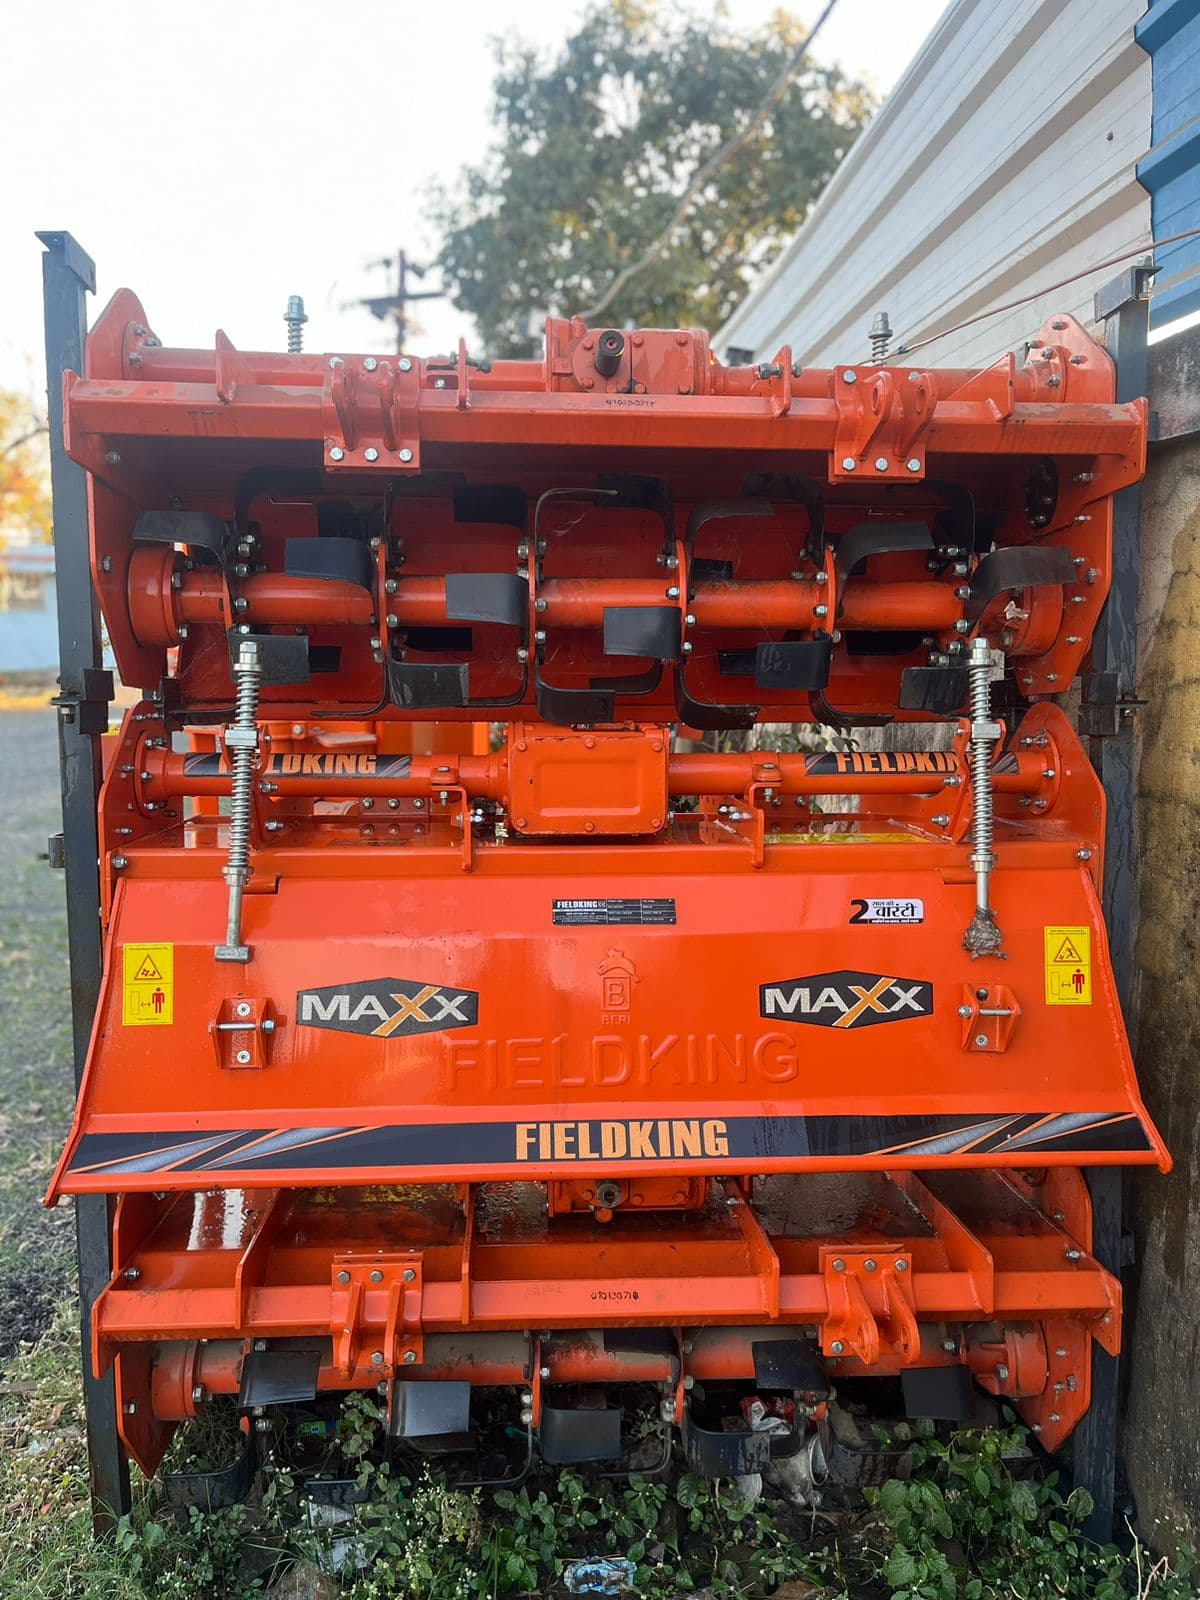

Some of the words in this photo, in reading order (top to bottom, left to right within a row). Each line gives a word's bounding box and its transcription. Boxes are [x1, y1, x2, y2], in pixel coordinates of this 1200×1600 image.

[849, 899, 869, 924] 2
[302, 985, 469, 1037] MAXX
[765, 977, 924, 1028] MAXX
[448, 1032, 800, 1089] FIELDKING
[515, 1120, 729, 1161] FIELDKING
